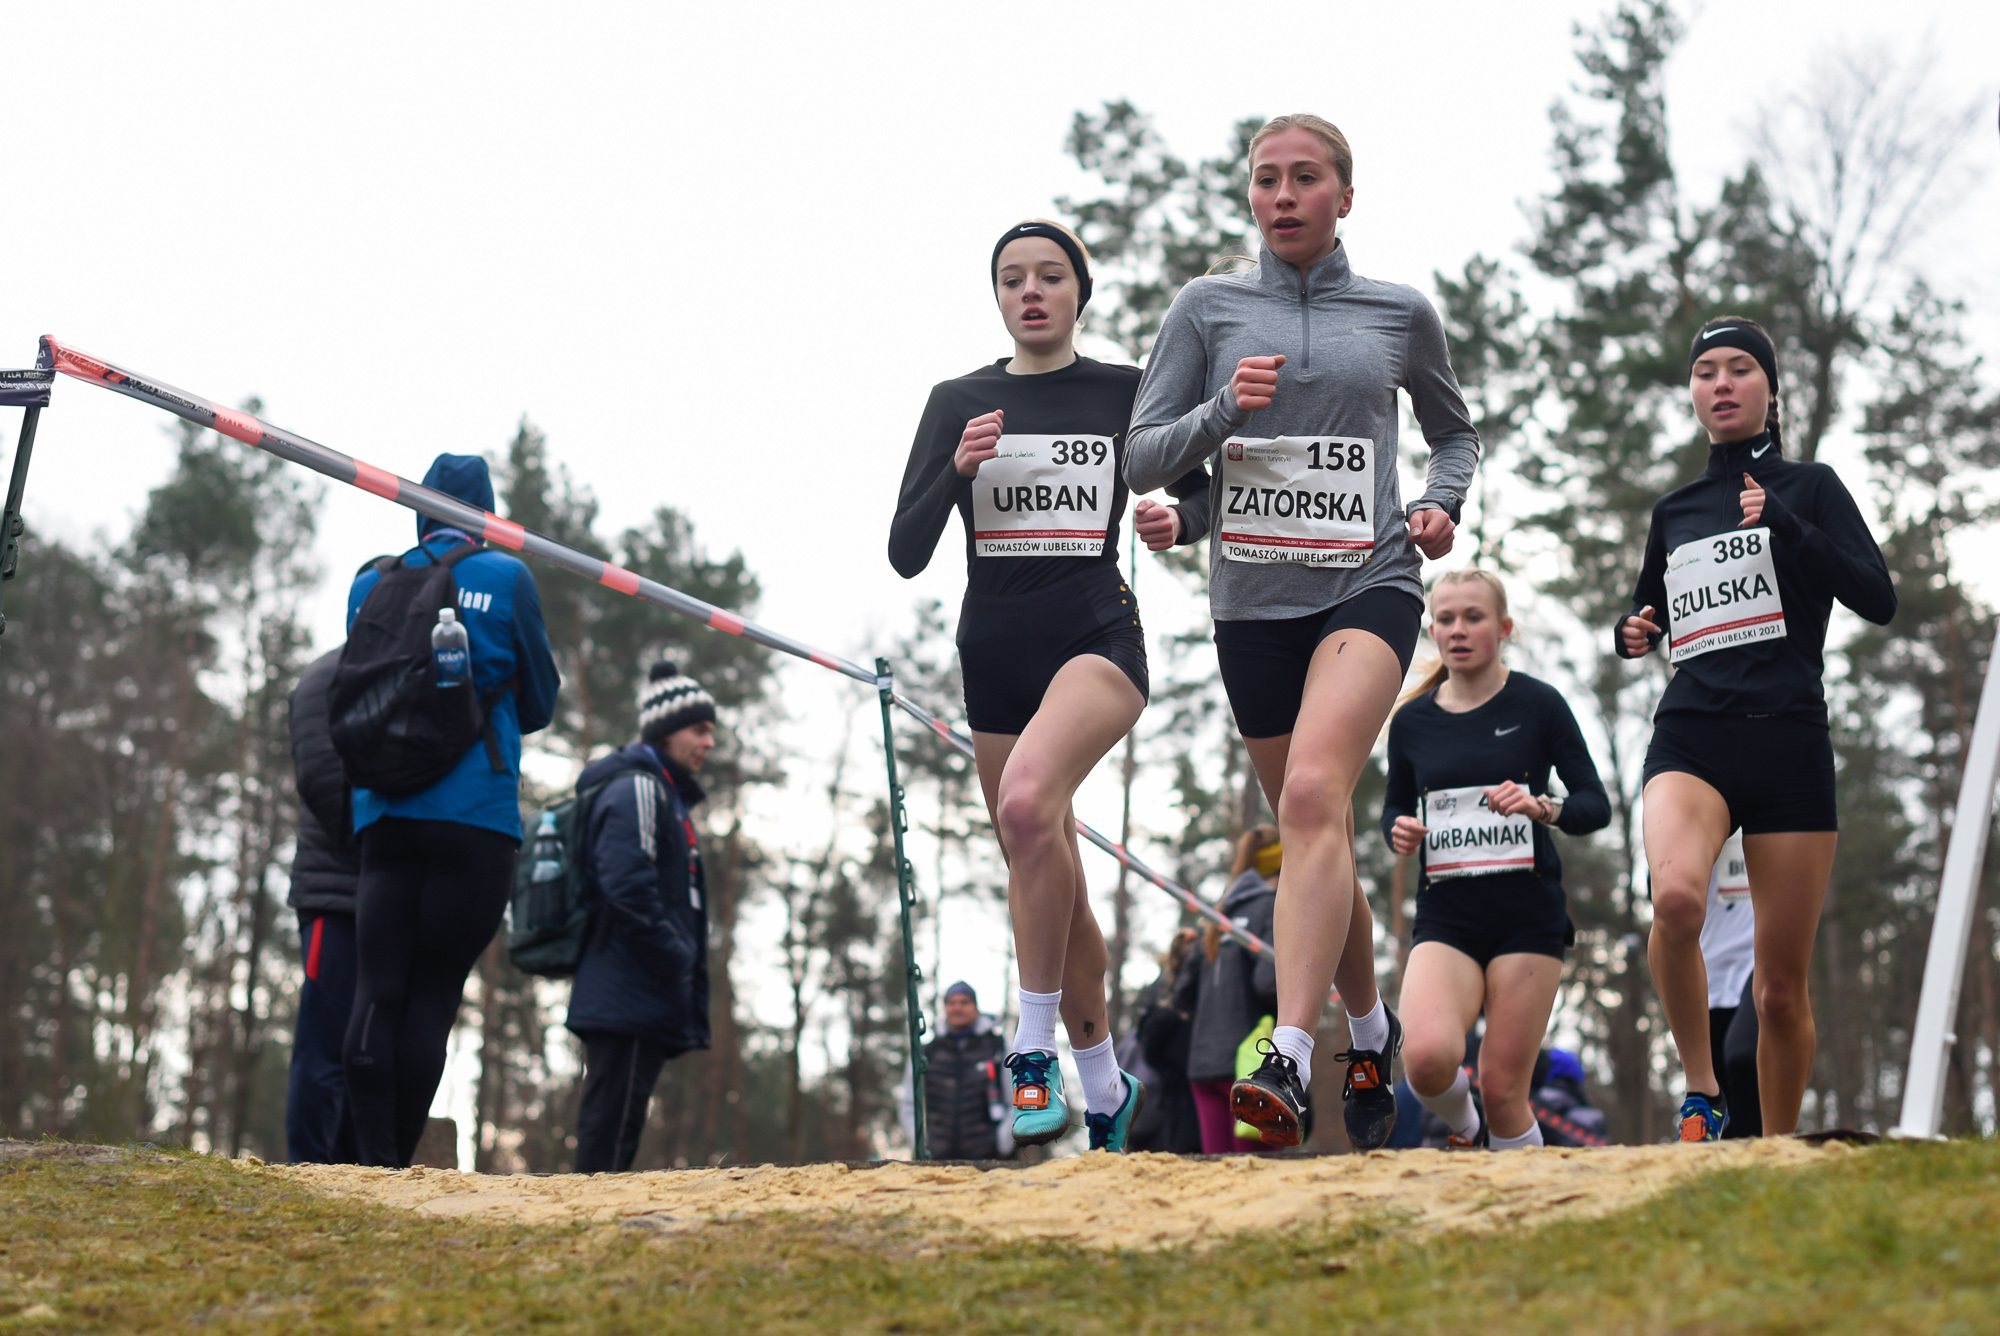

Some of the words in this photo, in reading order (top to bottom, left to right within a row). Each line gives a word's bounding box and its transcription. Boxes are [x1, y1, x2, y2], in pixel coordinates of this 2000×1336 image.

[1051, 440, 1108, 466] 389
[1306, 442, 1366, 472] 158
[993, 485, 1097, 513] URBAN
[1227, 486, 1367, 523] ZATORSKA
[984, 540, 1041, 553] TOMASZÓW
[1043, 542, 1087, 552] LUBELSKI
[1229, 546, 1290, 561] TOMASZÓW
[1291, 552, 1338, 563] LUBELSKI
[1340, 553, 1367, 563] 2021
[1712, 533, 1763, 564] 388
[1672, 573, 1773, 622] SZULSKA
[1675, 638, 1715, 658] TOMASZÓW
[1717, 630, 1757, 645] LUBELSKI
[1758, 624, 1781, 637] 2021
[1429, 824, 1528, 851] URBANIAK
